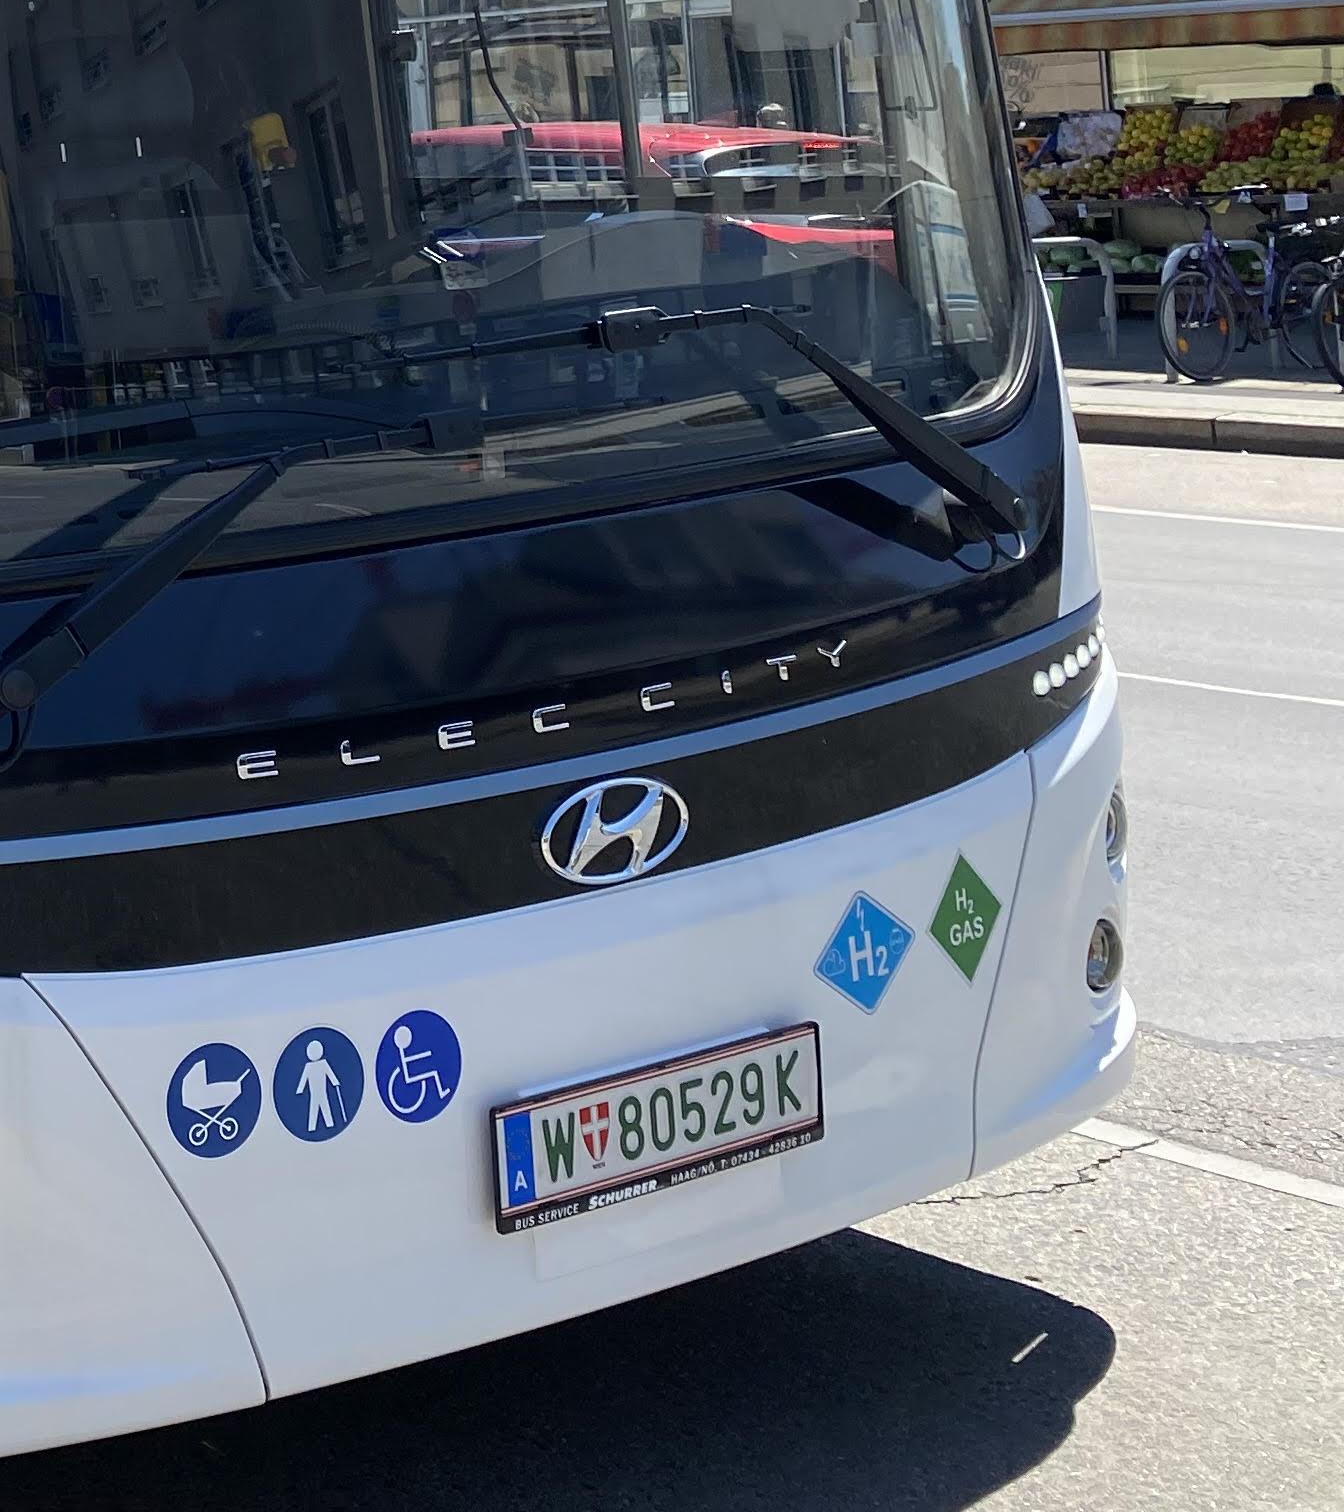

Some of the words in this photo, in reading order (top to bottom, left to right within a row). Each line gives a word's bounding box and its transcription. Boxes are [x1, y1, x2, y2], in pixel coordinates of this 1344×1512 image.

[949, 916, 985, 947] GAS
[542, 1112, 576, 1184] W
[514, 1170, 528, 1192] A
[515, 1215, 535, 1230] BUS
[538, 1203, 580, 1224] SERVICE
[588, 1179, 658, 1211] SCHURRER
